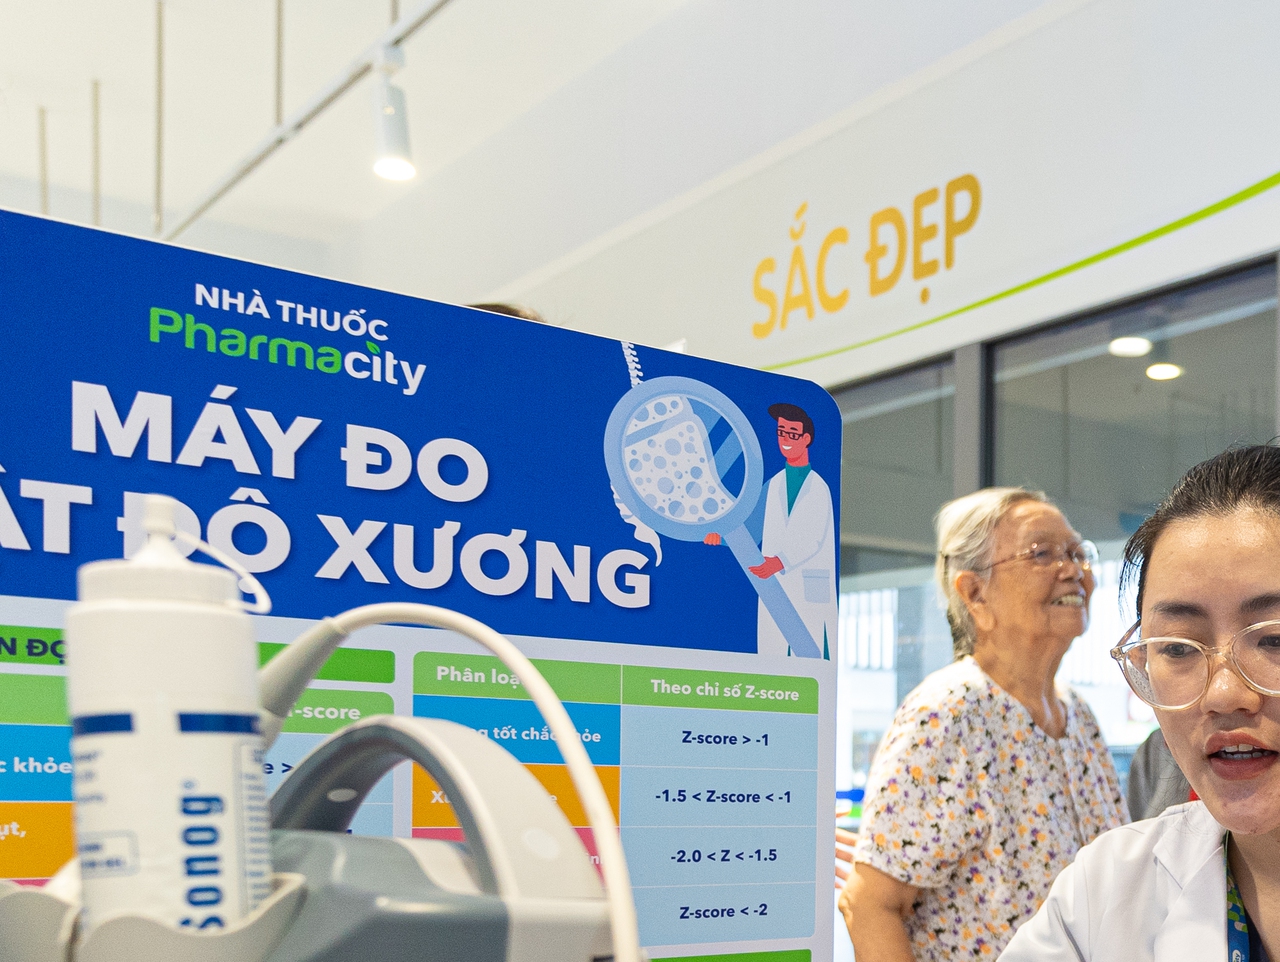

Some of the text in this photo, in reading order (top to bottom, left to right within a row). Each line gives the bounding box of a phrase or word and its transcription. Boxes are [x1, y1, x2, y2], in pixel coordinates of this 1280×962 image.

[752, 173, 981, 339] SẮC ĐẸP
[195, 283, 389, 341] NHÀ THUỐC
[150, 307, 427, 396] Pharmacity
[72, 380, 489, 502] MÁY ĐO
[314, 513, 651, 609] XƯƠNG
[437, 666, 522, 689] Phân loạ
[650, 679, 800, 701] Theo chỉ số Z-score
[493, 725, 517, 740] tốt
[682, 730, 738, 745] Z-score
[755, 734, 769, 746] -1
[13, 756, 73, 774] khỏe
[655, 789, 687, 803] -1.5
[706, 790, 761, 803] Z-score
[778, 791, 791, 804] -1
[670, 849, 702, 863] -2.0
[721, 850, 731, 863] Z
[748, 849, 777, 862] -1.5
[679, 904, 735, 919] Z-score
[753, 903, 768, 917] -2
